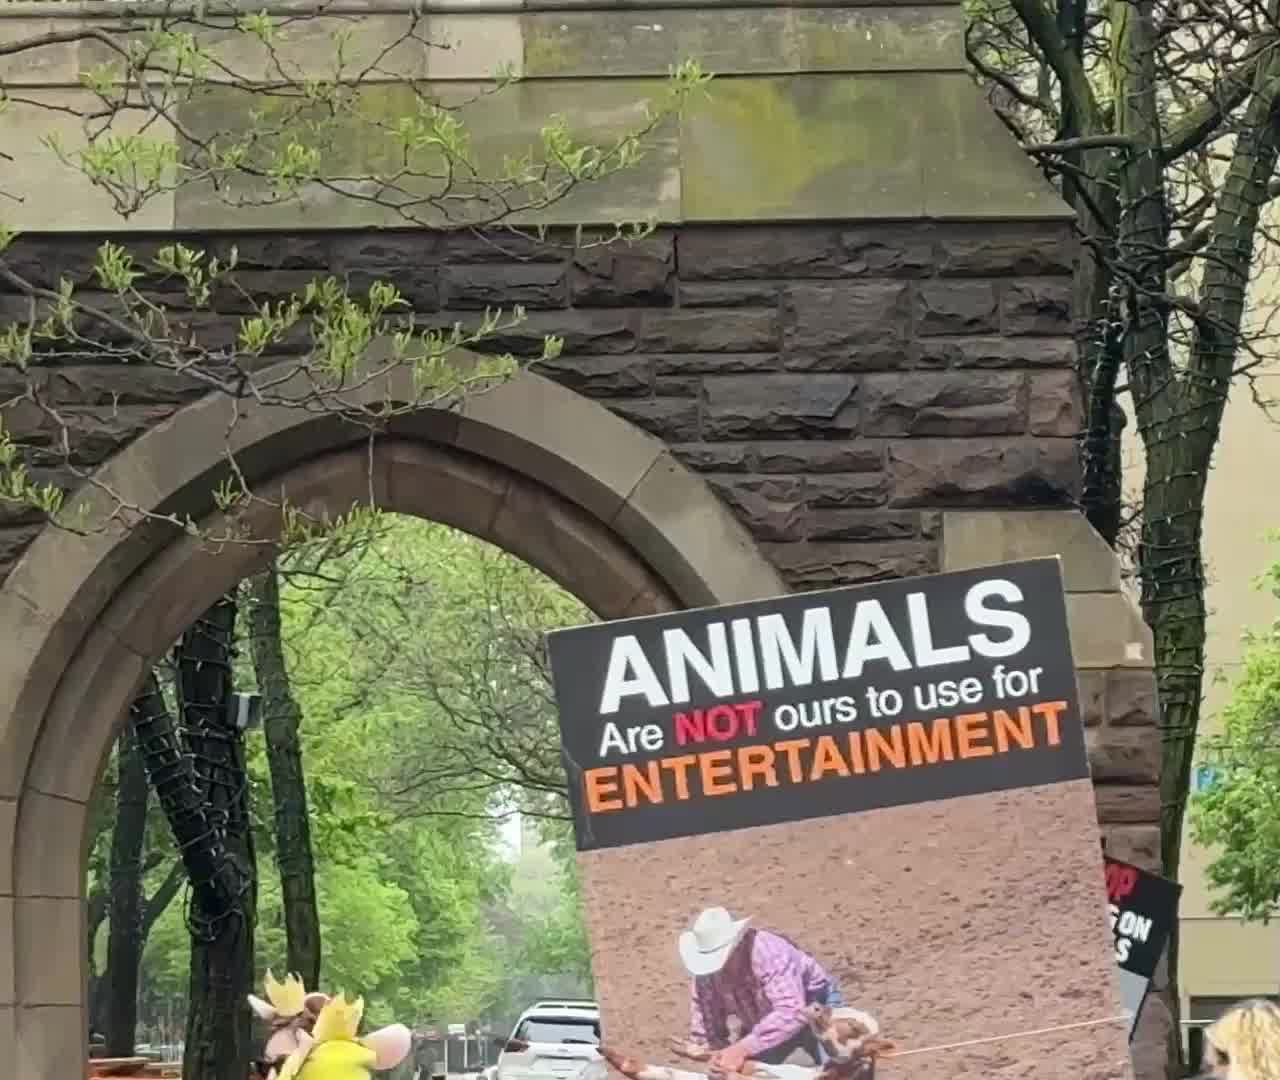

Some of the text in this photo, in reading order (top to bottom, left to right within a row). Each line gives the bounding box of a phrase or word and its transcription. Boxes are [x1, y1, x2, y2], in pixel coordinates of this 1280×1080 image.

[599, 579, 1032, 715] ANIMALS
[584, 701, 1068, 813] ENTERTAINMENT
[599, 665, 1043, 758] Are NOT ours to use for
[1119, 911, 1152, 943] ON
